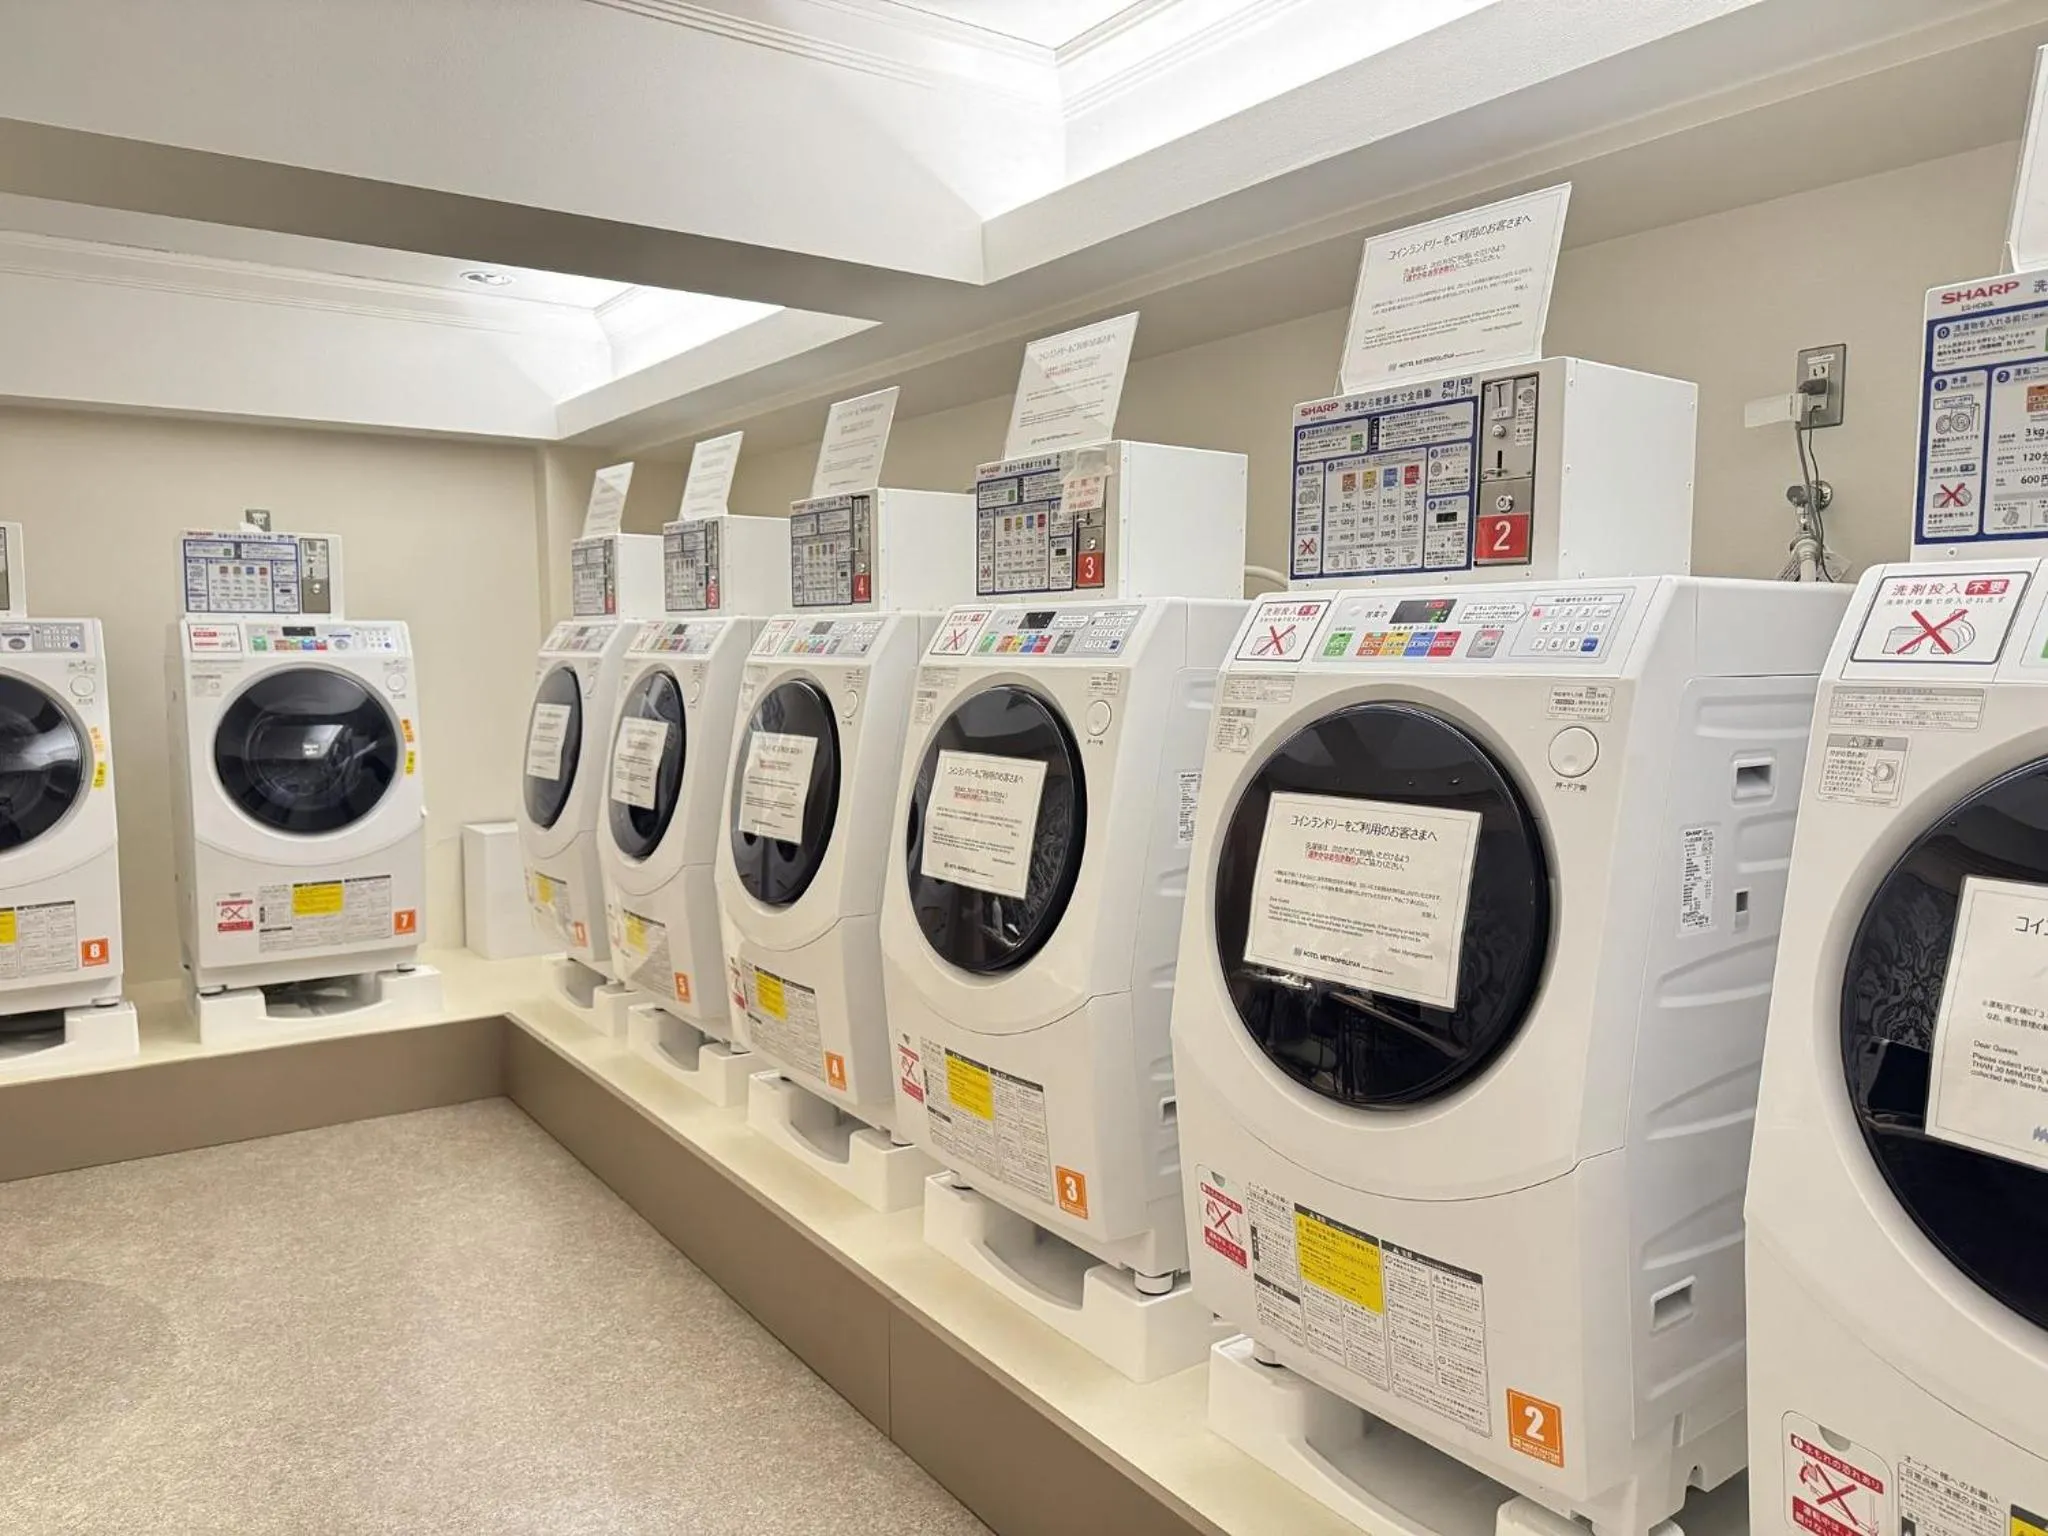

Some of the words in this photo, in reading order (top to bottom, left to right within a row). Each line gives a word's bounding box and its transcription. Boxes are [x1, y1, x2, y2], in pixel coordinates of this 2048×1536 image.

[1941, 281, 2020, 305] SHARP
[1301, 402, 1340, 417] SHARP
[1493, 520, 1511, 551] 2
[1085, 556, 1094, 579] 3
[858, 577, 865, 595] 4
[1892, 582, 1961, 597] 洗剤投入
[1290, 815, 1438, 842] コインランドリーをご利用のお客さまへ
[400, 913, 409, 929] 7
[1973, 1039, 1991, 1050] Dear
[831, 1058, 840, 1081] 4
[1065, 1175, 1078, 1201] 3
[1524, 1404, 1545, 1442] 2
